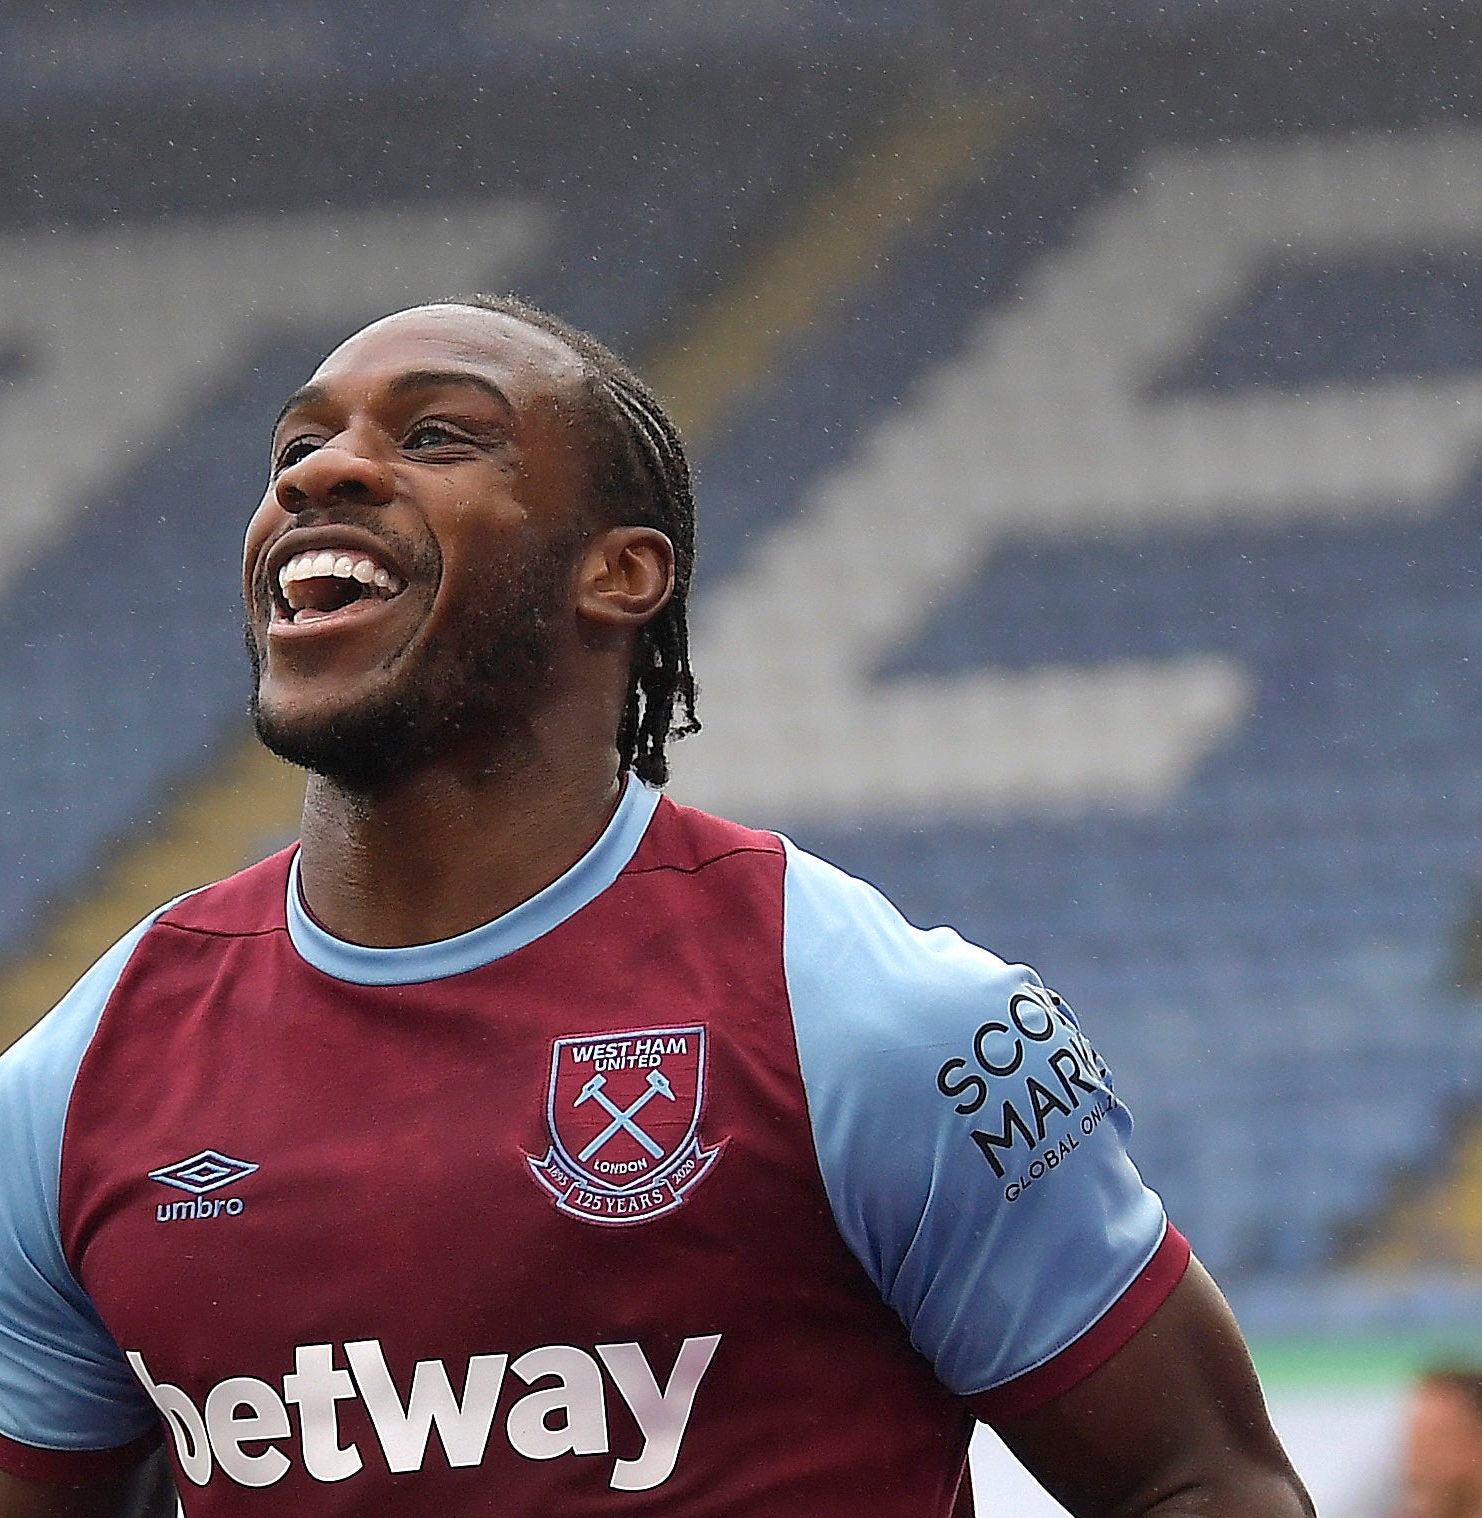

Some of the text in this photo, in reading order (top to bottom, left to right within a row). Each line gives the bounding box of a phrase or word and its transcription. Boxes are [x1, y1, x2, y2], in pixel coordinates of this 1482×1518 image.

[572, 1037, 687, 1063] WEST HAM
[594, 1053, 661, 1072] UNITED
[593, 1157, 648, 1175] LONDON
[671, 1159, 696, 1185] 2020
[1004, 1133, 1080, 1202] GLOBAL
[155, 1194, 244, 1222] umbro
[574, 1188, 664, 1213] 125 YEARS
[126, 1334, 721, 1491] betway
